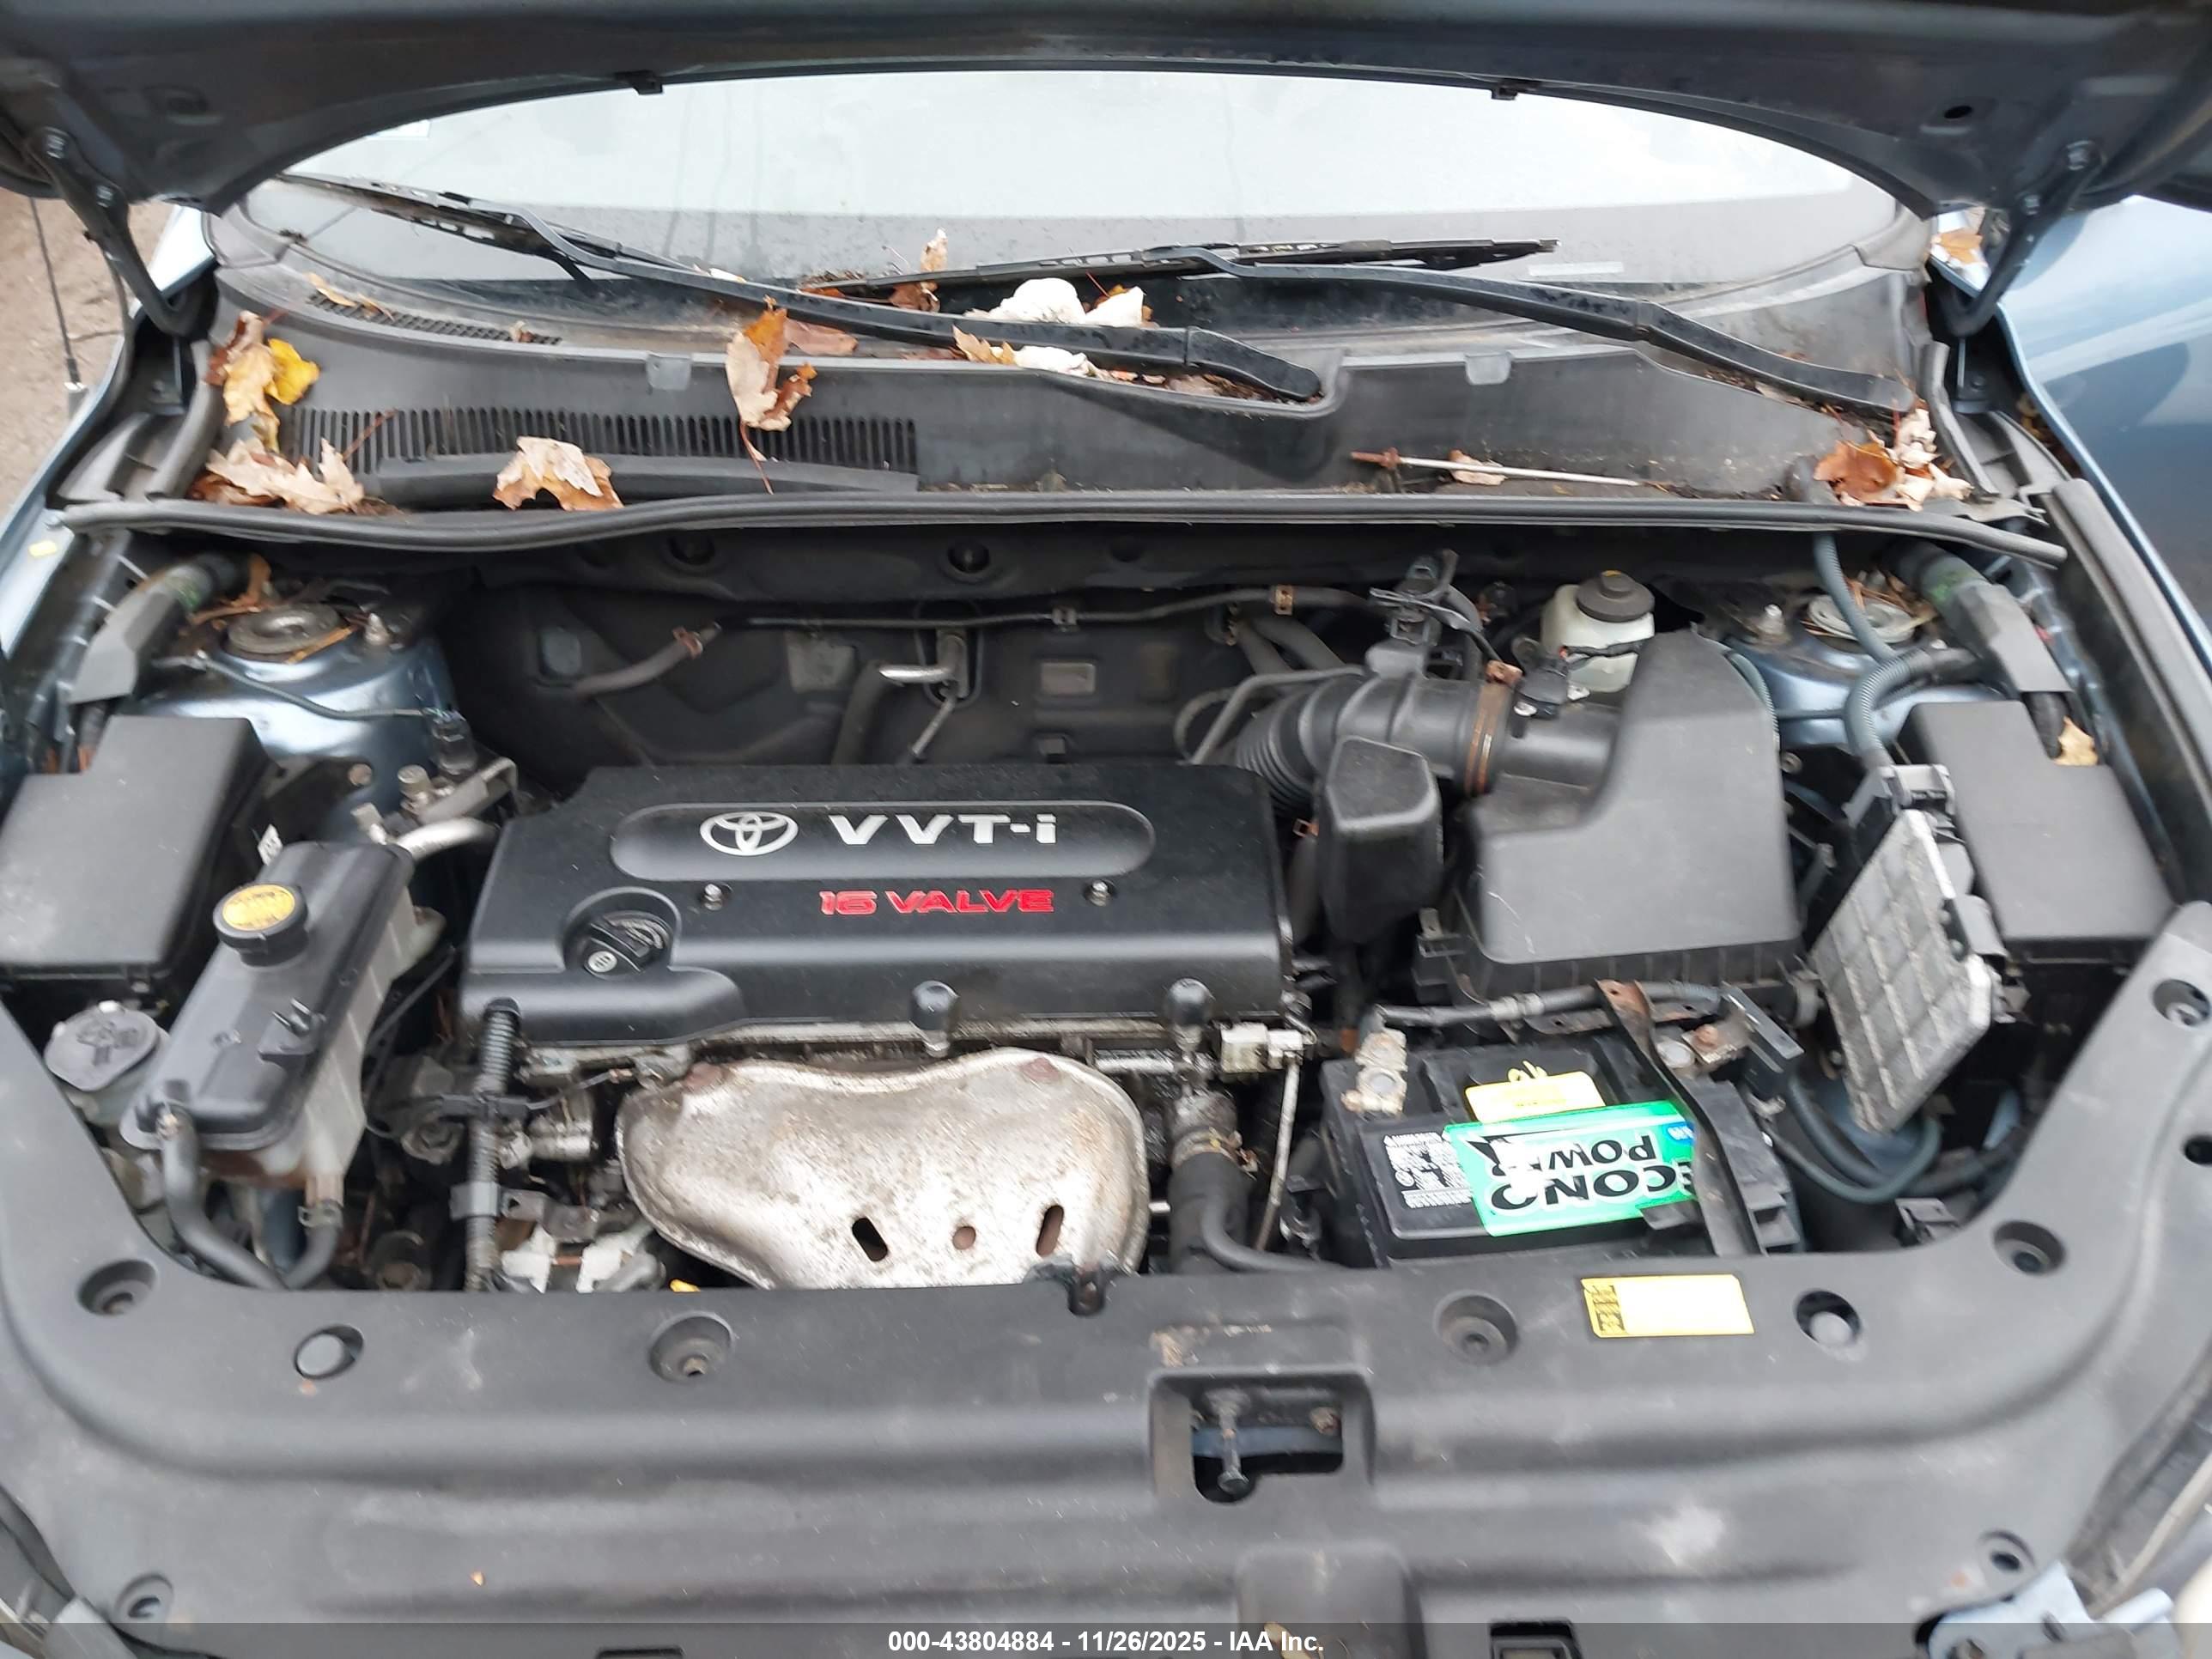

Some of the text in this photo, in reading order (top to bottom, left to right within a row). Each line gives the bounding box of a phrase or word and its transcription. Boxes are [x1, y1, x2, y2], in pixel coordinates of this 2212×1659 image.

[829, 814, 1057, 845] VVT-i
[819, 889, 1055, 915] 16 VALVE
[1468, 1134, 1657, 1178] POWR
